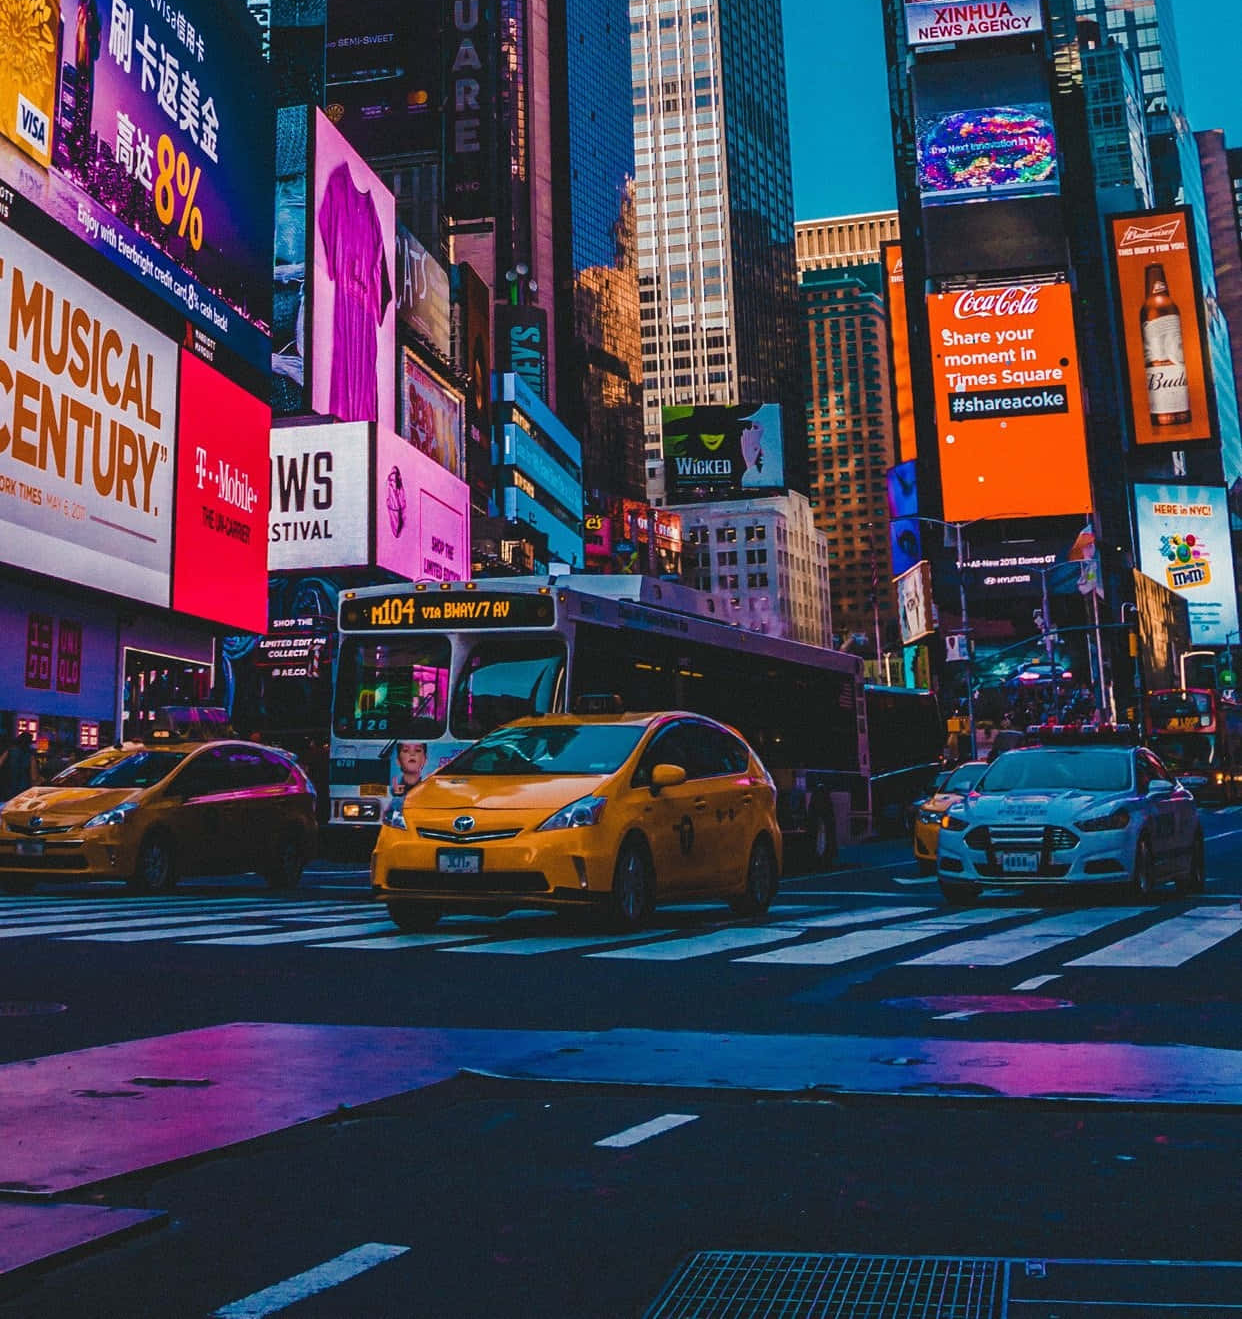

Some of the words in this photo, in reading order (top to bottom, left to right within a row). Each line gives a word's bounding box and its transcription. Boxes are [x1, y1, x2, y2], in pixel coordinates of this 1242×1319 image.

[934, 1, 1013, 25] XINHUA
[918, 24, 963, 40] NEWS
[967, 16, 1032, 35] AGENCY
[20, 102, 46, 146] VISA
[77, 203, 100, 238] Enjoy
[100, 224, 118, 249] with
[117, 234, 153, 276] Everbright
[154, 266, 174, 291] credit
[200, 301, 214, 323] cash
[954, 286, 1041, 319] Coca-Cola
[9, 267, 161, 430] MUSICAL
[942, 329, 991, 346] Share
[995, 328, 1034, 345] your
[944, 349, 1016, 367] moment
[1020, 347, 1037, 361] in
[945, 373, 998, 389] Times
[1001, 368, 1062, 385] Square
[953, 392, 1064, 413] #shareacoke
[270, 451, 333, 513] WS
[1154, 504, 1178, 515] HERE
[1189, 506, 1212, 516] NYC!
[269, 520, 332, 542] STIVAL
[371, 598, 415, 625] M104
[422, 607, 441, 618] VIA
[443, 602, 490, 618] BWAY/7
[493, 601, 510, 618] AV
[260, 640, 292, 648] LIMITED
[293, 638, 327, 647] EDITON
[268, 649, 309, 658] COLLECTI
